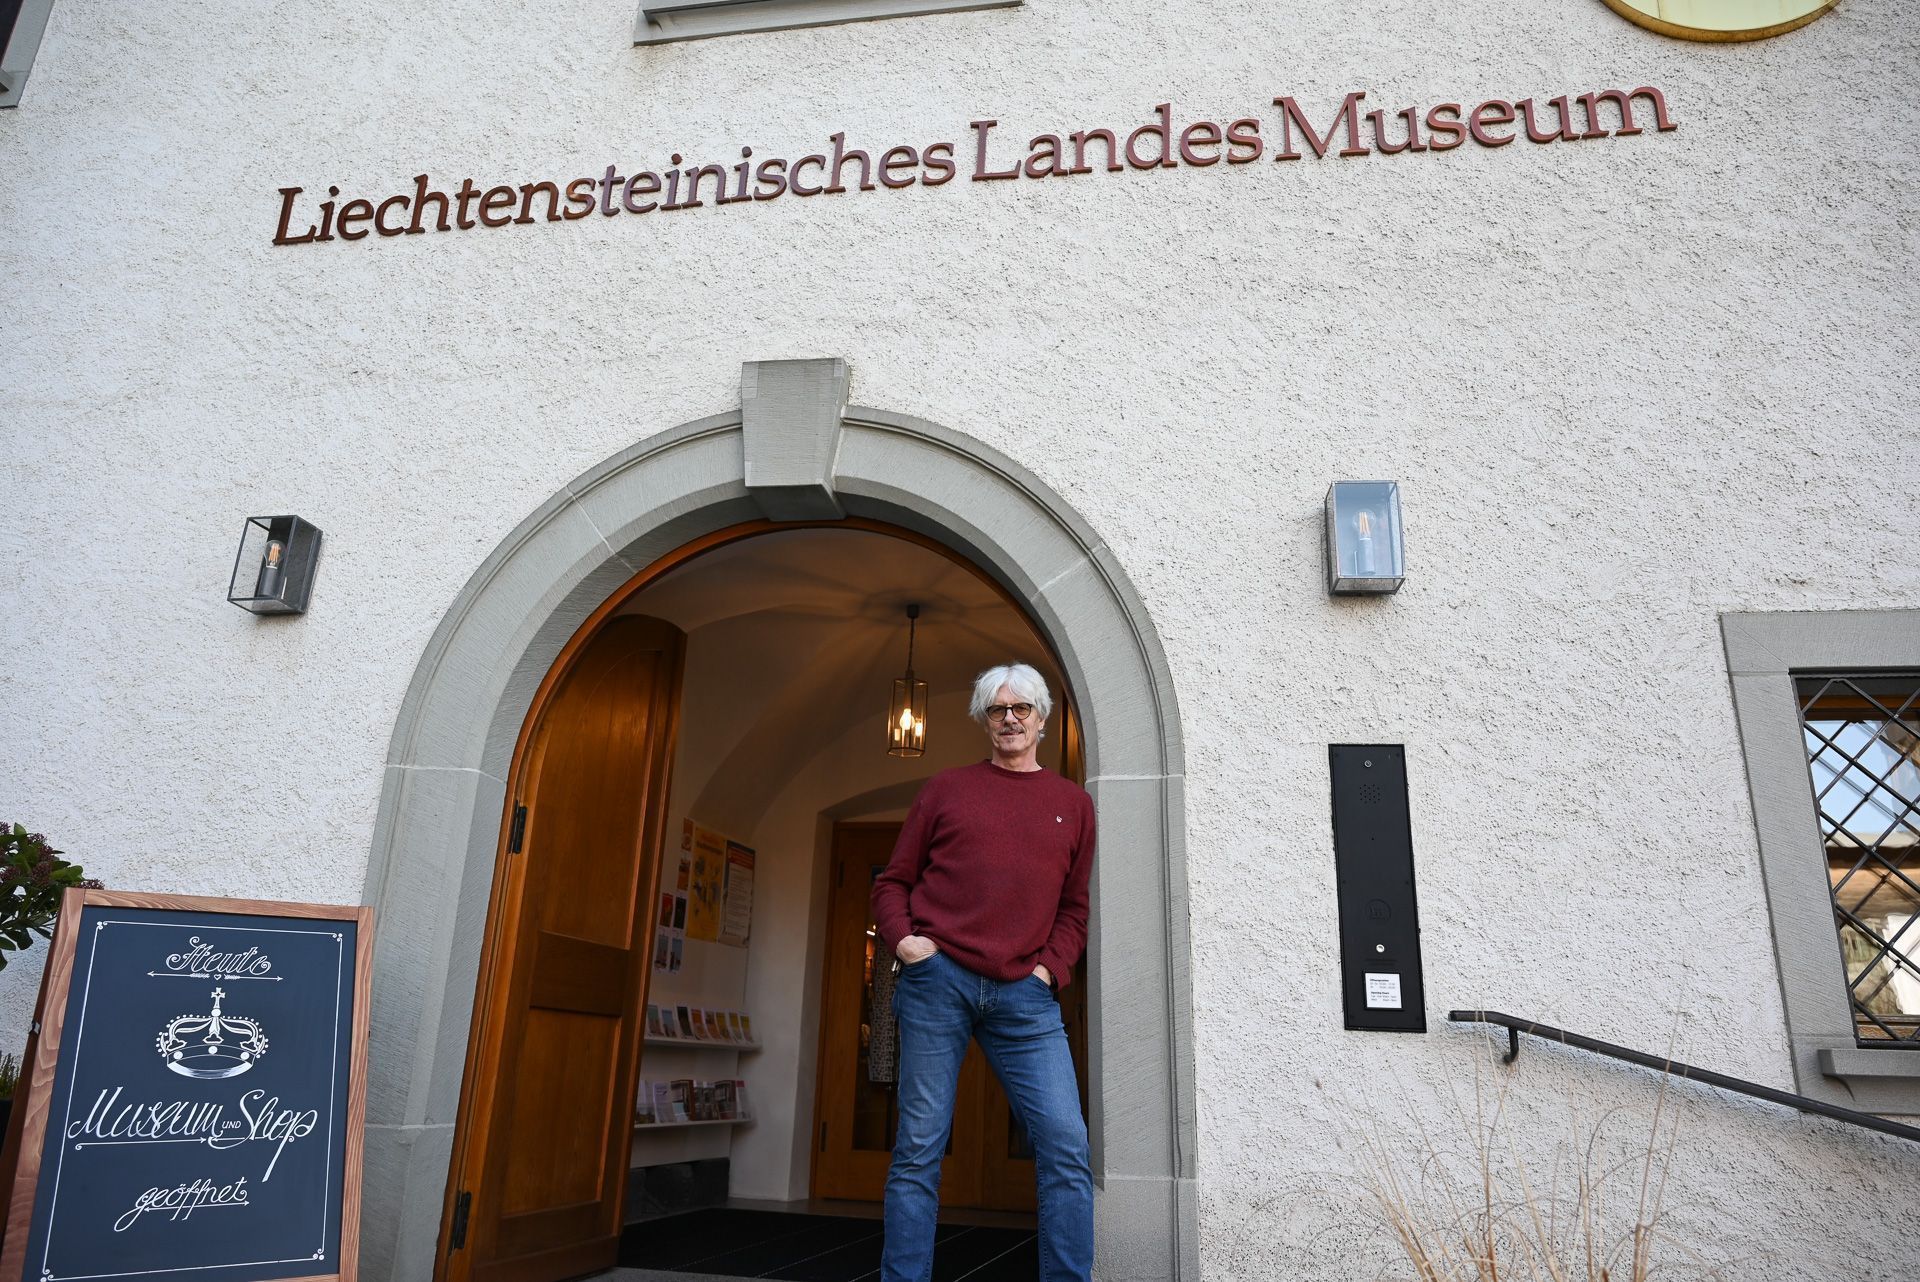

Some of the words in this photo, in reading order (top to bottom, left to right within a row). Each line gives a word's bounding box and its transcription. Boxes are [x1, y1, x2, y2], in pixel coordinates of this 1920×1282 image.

[273, 132, 956, 246] Liechtensteinisches
[165, 936, 272, 976] Heute
[67, 1086, 224, 1139] Museum
[208, 1089, 319, 1183] Shop
[221, 1120, 242, 1130] UND
[114, 1176, 248, 1232] geöffnet
